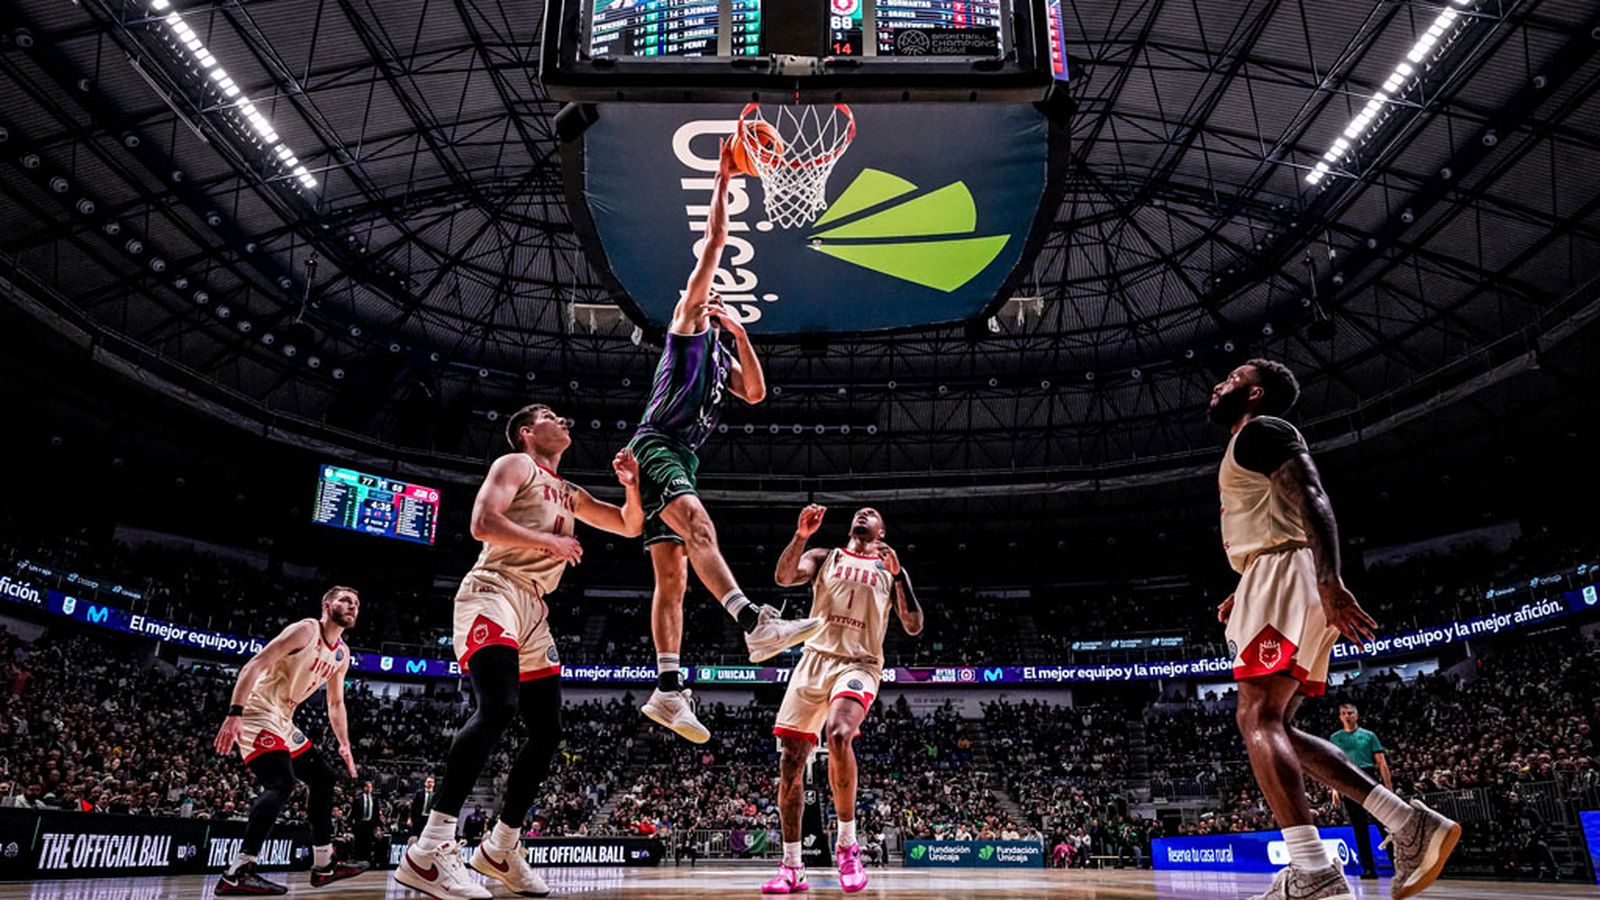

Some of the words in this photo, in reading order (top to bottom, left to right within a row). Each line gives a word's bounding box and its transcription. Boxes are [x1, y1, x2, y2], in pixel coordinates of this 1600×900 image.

[831, 17, 852, 28] 68
[834, 43, 851, 54] 14
[0, 576, 41, 603] fición.
[848, 589, 855, 609] 1
[130, 615, 144, 631] El
[145, 622, 188, 641] mejor
[188, 631, 237, 650] equipo
[237, 640, 248, 654] y
[250, 639, 263, 653] la
[1333, 644, 1348, 658] El
[1393, 629, 1443, 649] equipo
[1443, 627, 1454, 643] y
[1454, 621, 1470, 637] la
[1470, 613, 1512, 633] mejor
[1513, 598, 1564, 623] afición.
[561, 665, 573, 678] la
[575, 666, 612, 681] mejor
[718, 670, 755, 680] UNICAJA
[777, 669, 790, 681] 77
[1023, 667, 1037, 679] El
[1038, 666, 1076, 682] mejor
[1077, 665, 1123, 681] equipo
[1124, 667, 1133, 680] y
[1134, 663, 1148, 677] la
[1149, 662, 1189, 678] mejor
[38, 834, 74, 869] THE
[72, 834, 140, 868] OFFICIAL
[137, 835, 172, 867] BALL
[207, 838, 231, 867] THE
[270, 840, 293, 865] BALL
[528, 847, 550, 864] THE
[549, 846, 599, 863] OFFICIAL
[599, 846, 626, 863] BALL
[928, 845, 971, 855] Fundación
[929, 853, 960, 862] Unicaja
[996, 846, 1039, 855] Fundación
[997, 853, 1029, 862] Unicaja
